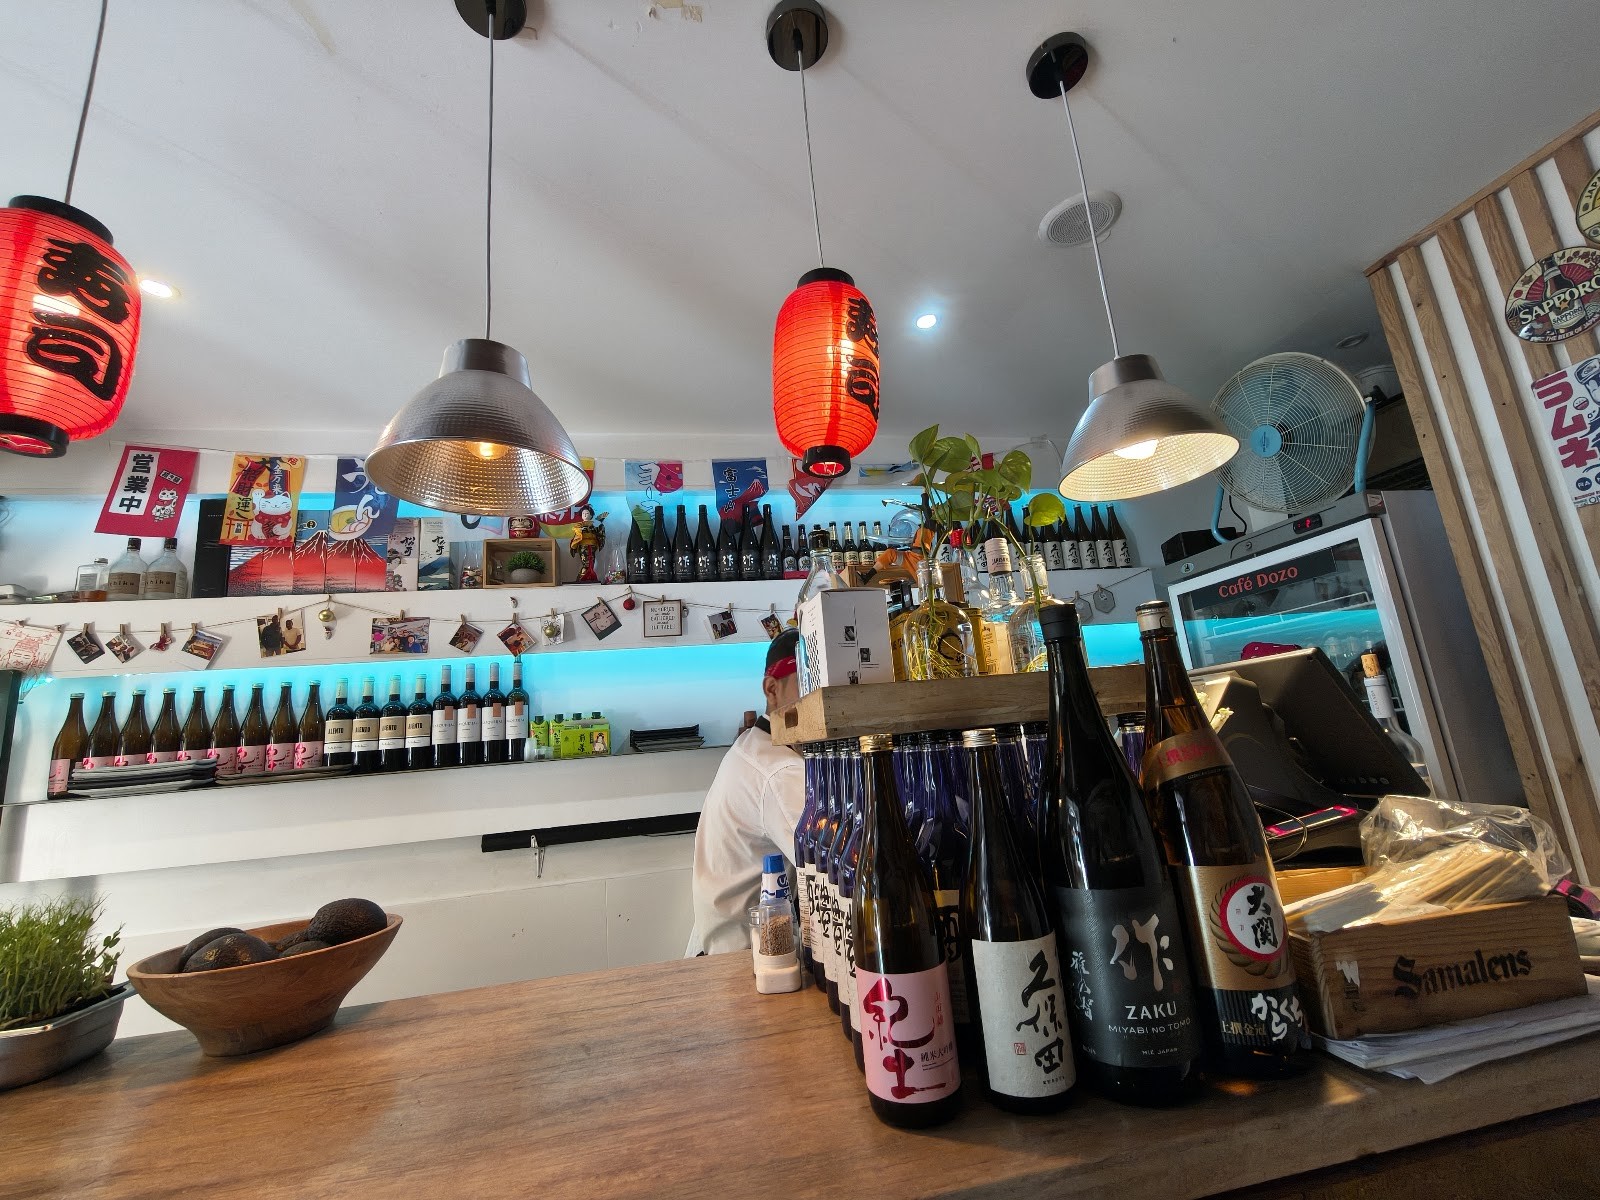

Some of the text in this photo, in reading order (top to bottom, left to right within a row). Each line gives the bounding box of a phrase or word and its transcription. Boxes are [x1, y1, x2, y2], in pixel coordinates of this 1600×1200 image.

[1534, 370, 1598, 468] ラムネ
[119, 454, 154, 512] 営業中
[723, 467, 740, 513] 富士山
[1219, 566, 1298, 598] Café Dozo
[1247, 885, 1279, 949] 大関
[1393, 949, 1532, 1000] Samalens
[1016, 949, 1064, 1074] 久保田
[1108, 1017, 1191, 1034] MIYABI NO TOMO
[1125, 1001, 1177, 1020] ZAKU
